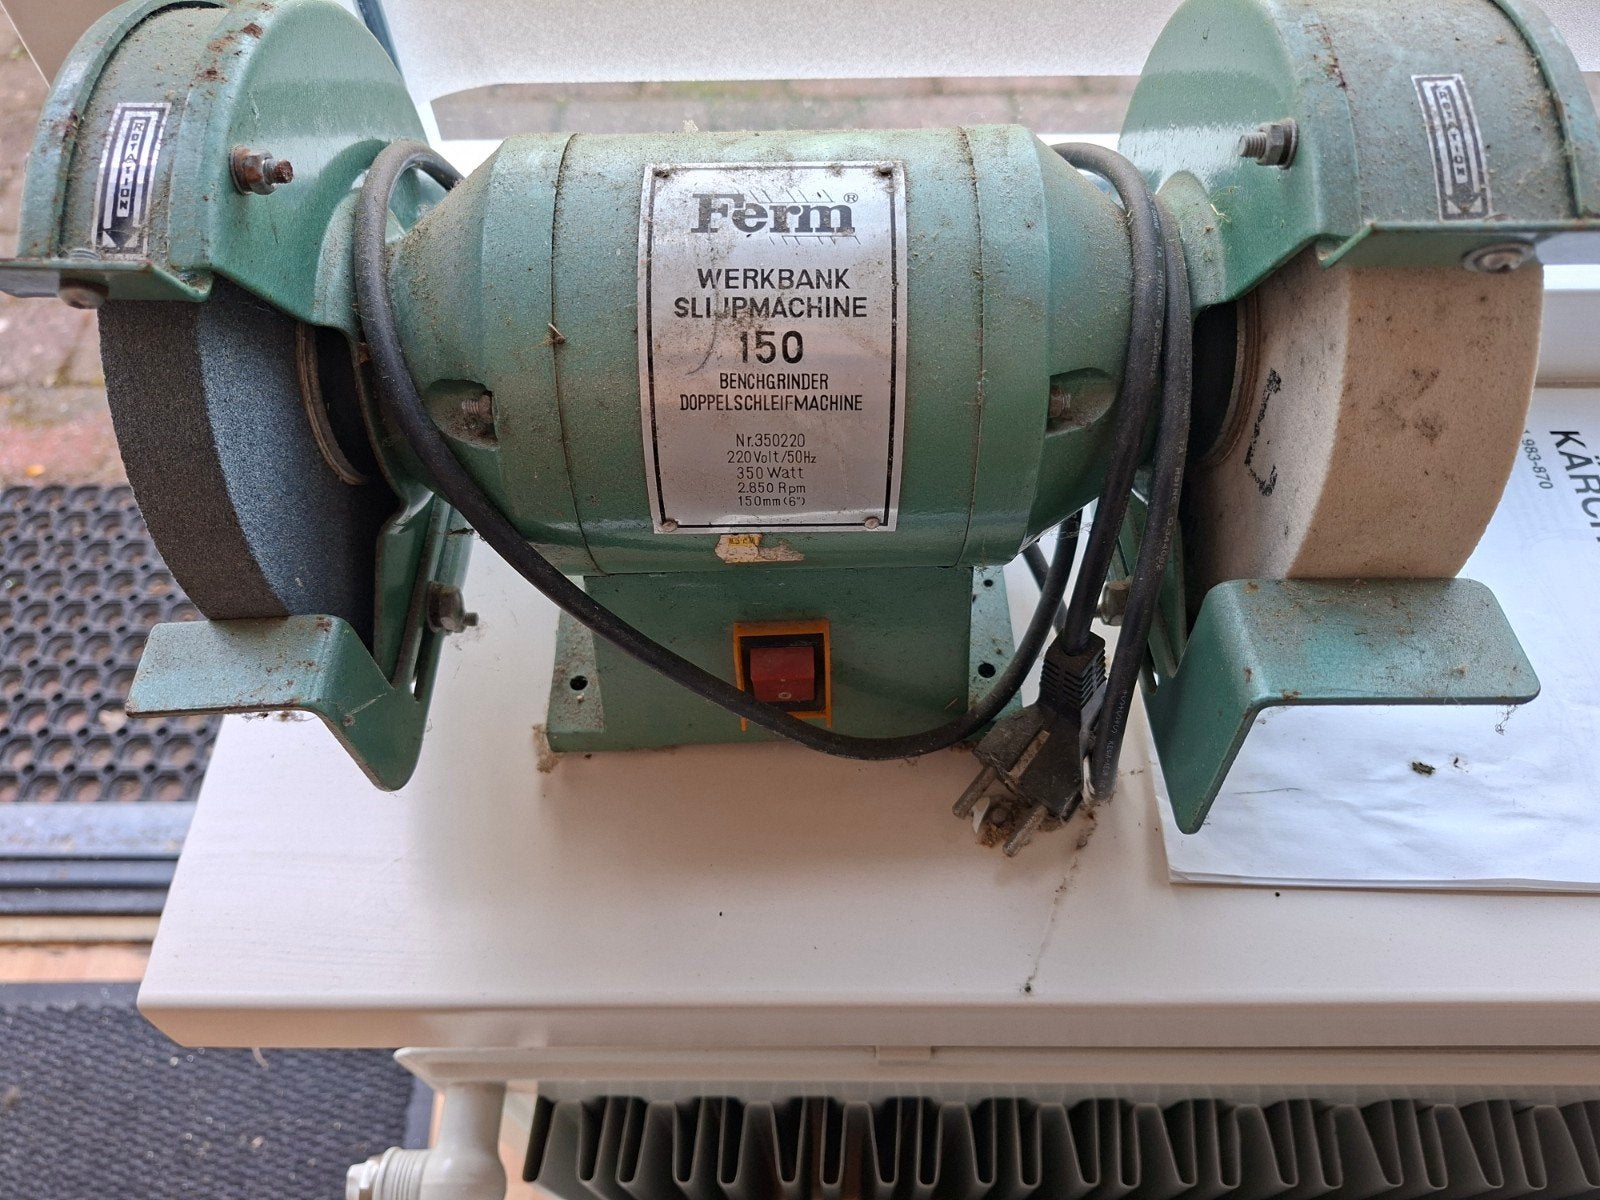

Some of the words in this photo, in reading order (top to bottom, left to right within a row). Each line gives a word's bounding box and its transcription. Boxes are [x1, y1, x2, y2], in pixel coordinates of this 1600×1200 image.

[118, 121, 145, 211] ROTATION
[697, 268, 851, 290] WERKBANK
[740, 330, 804, 364] 150
[719, 372, 829, 390] BENCHGRINDER
[680, 394, 863, 411] DOPPELSCHLEIFMACHINE
[735, 433, 806, 448] Nr.350220
[736, 466, 764, 480] 350
[766, 466, 804, 479] Watt
[737, 481, 774, 494] 2.850
[778, 481, 806, 496] Rpm
